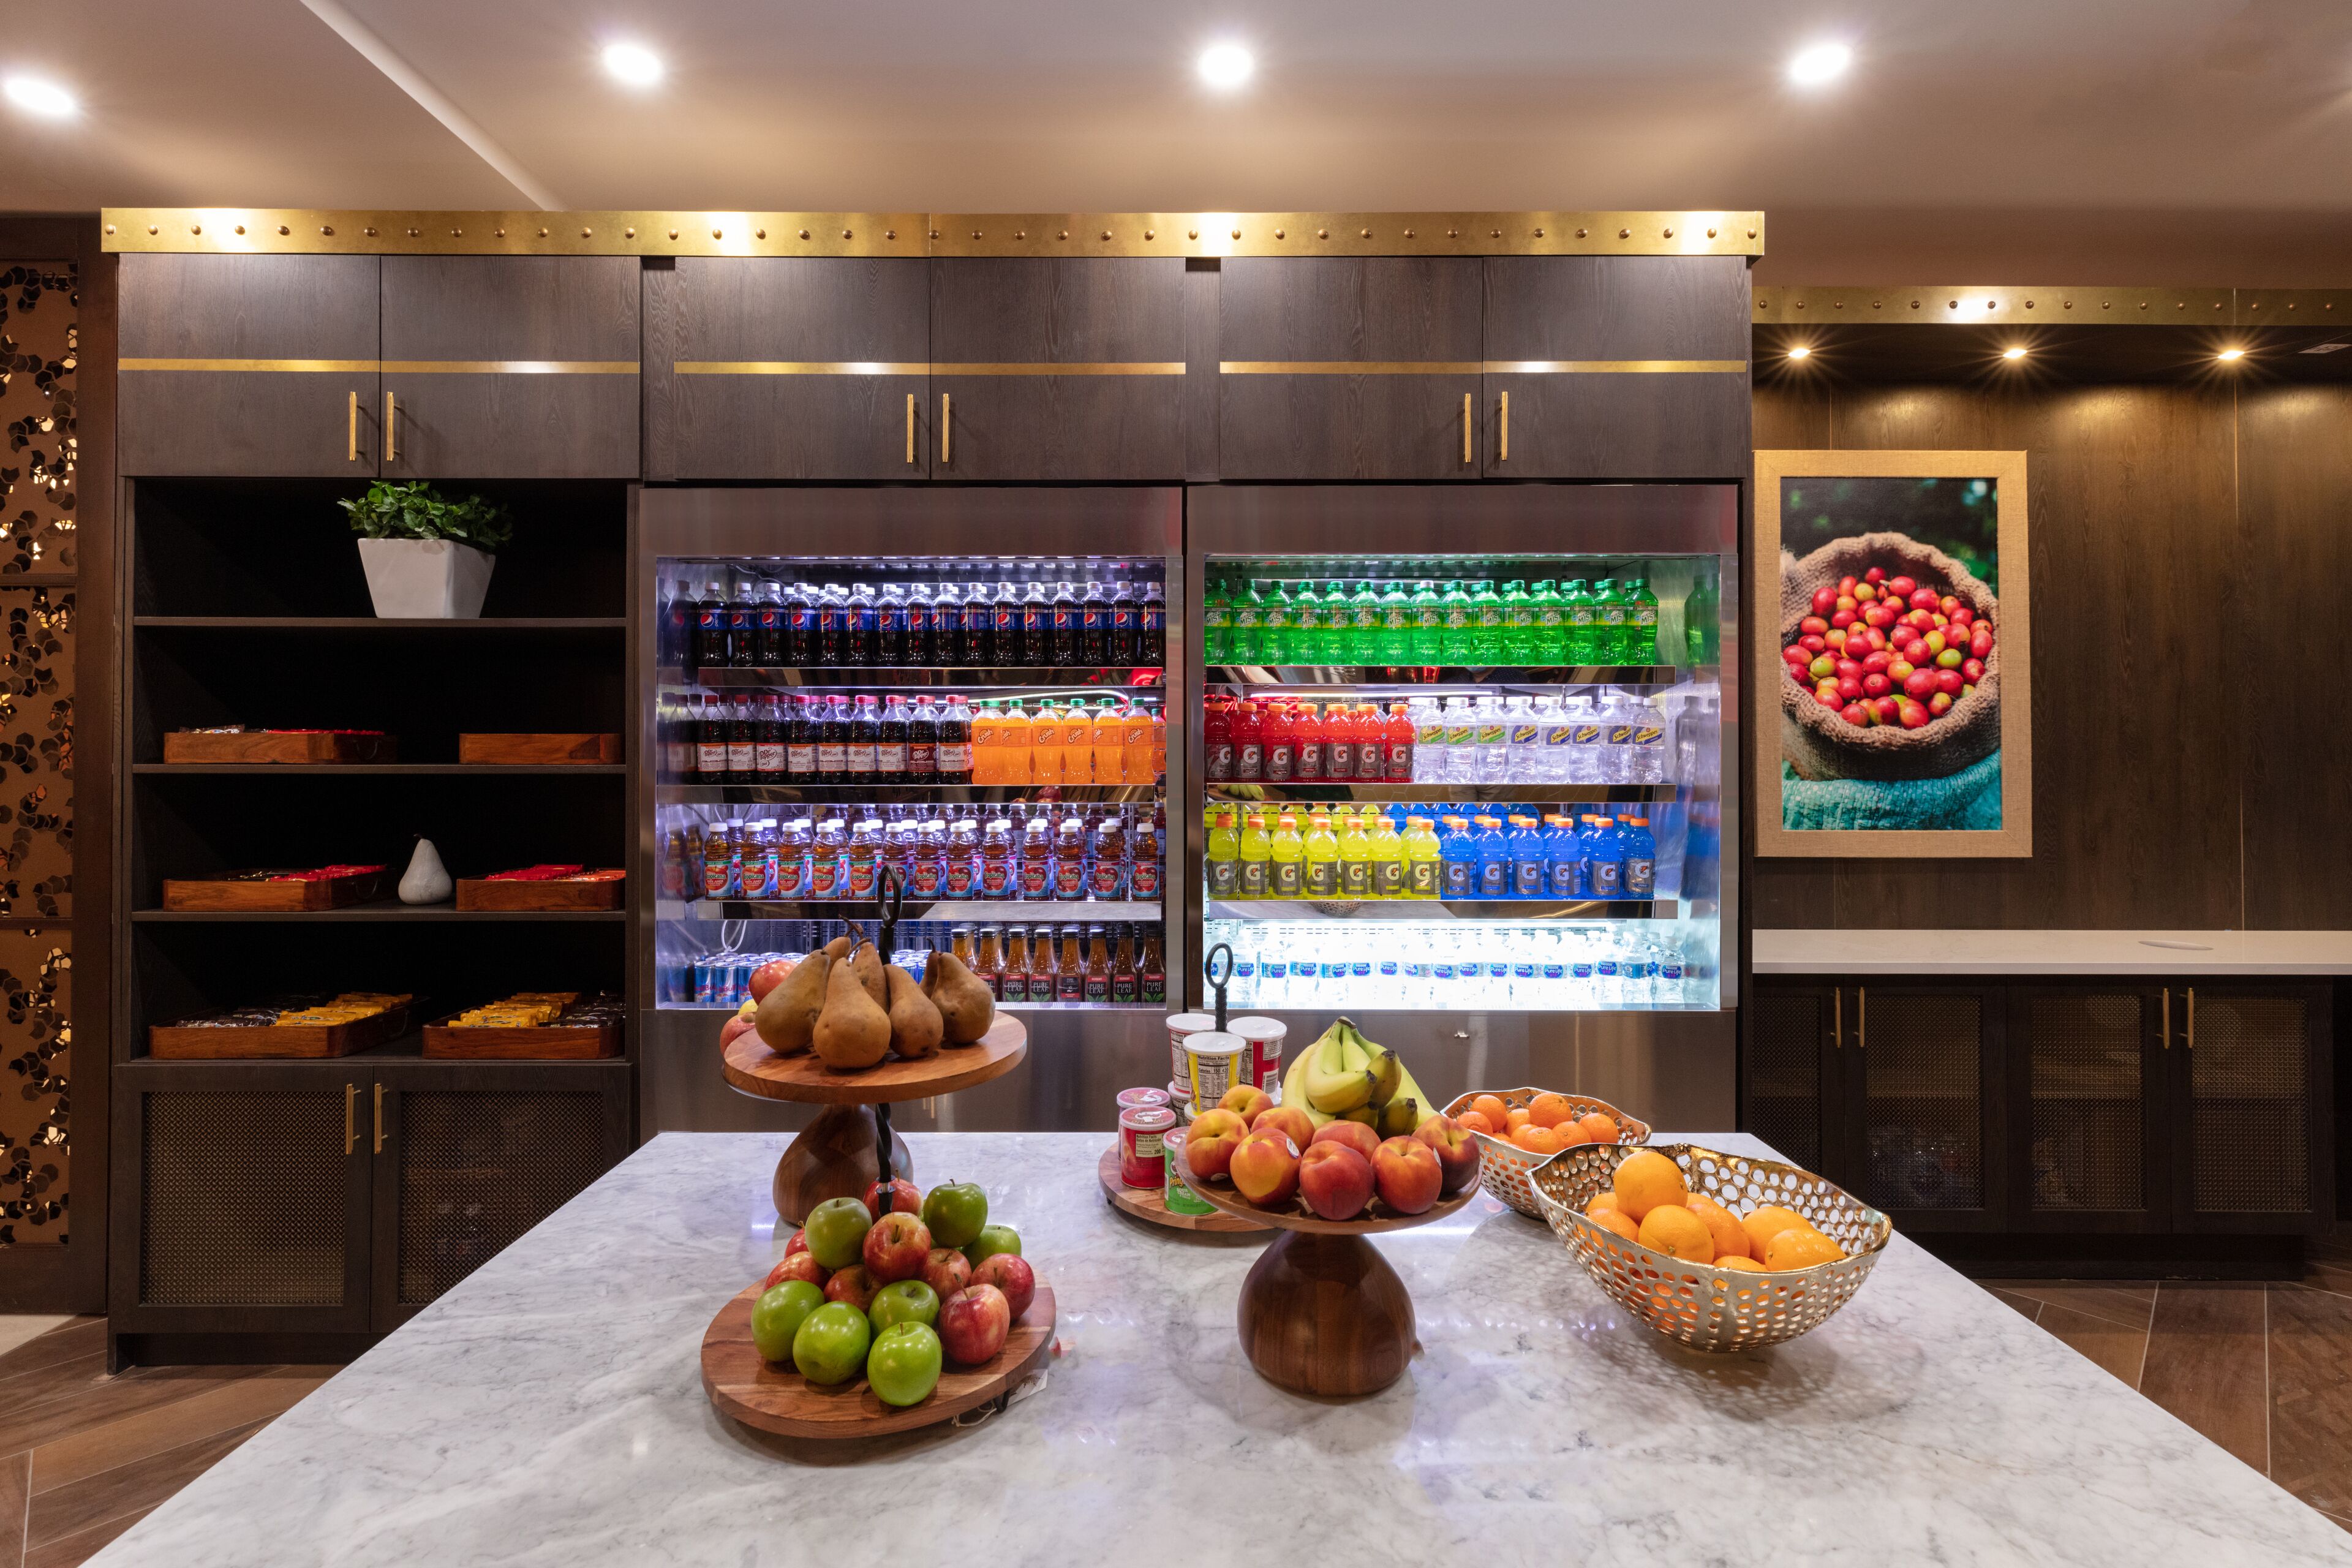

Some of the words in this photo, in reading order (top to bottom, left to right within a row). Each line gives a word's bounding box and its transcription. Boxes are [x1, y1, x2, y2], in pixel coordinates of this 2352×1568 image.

[1240, 614, 1255, 625] MIST
[1269, 614, 1284, 625] MIST
[978, 729, 993, 744] Crush
[1039, 729, 1055, 744] Crush
[1068, 729, 1084, 744] Crush
[1128, 729, 1144, 744] Crush
[1423, 728, 1442, 740] Schweppes
[1449, 729, 1468, 740] Schweppes
[1482, 728, 1501, 740] Schweppes
[1515, 728, 1535, 740] Schweppes
[1578, 728, 1597, 740] Schweppes
[1637, 730, 1657, 740] Schweppes
[760, 751, 775, 760] Pepper
[1219, 747, 1231, 763] G
[1243, 747, 1257, 763] G
[1273, 748, 1287, 764] G
[1303, 746, 1317, 762] G
[1334, 746, 1347, 762] G
[1362, 746, 1375, 763] G
[1392, 746, 1406, 763] G
[1216, 864, 1229, 881] G
[1246, 864, 1260, 881] G
[1281, 865, 1295, 881] G
[1311, 864, 1324, 881] G
[1349, 864, 1363, 881] G
[1386, 864, 1399, 880] G
[1415, 864, 1430, 880] G
[1449, 865, 1463, 880] G
[1485, 864, 1499, 880] G
[1521, 864, 1537, 880] G
[1555, 864, 1569, 881] G
[1600, 864, 1615, 881] G
[1635, 862, 1650, 878] G
[1170, 1177, 1185, 1188] Pring
